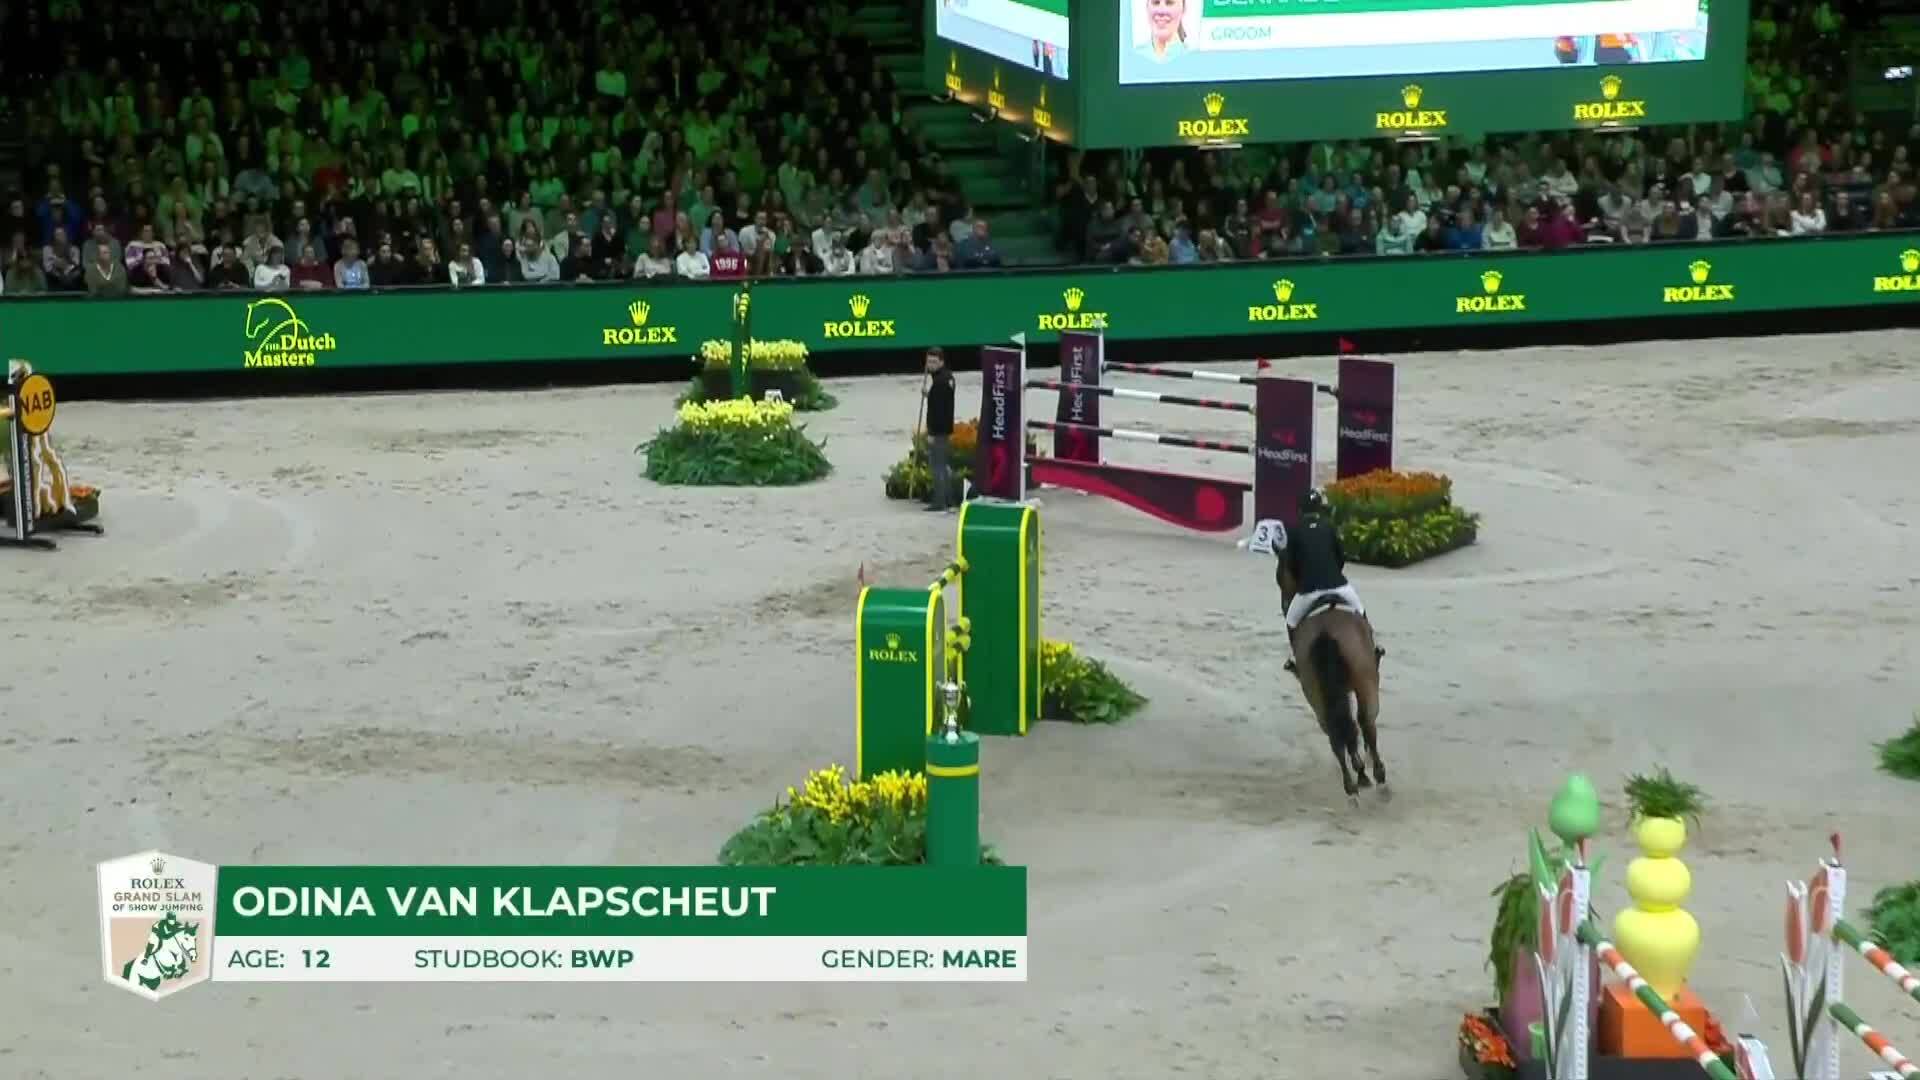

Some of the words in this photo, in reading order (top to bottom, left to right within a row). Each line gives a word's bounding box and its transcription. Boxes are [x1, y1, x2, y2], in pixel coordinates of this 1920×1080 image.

[1211, 26, 1272, 40] GROOM
[1574, 101, 1645, 119] ROLEX
[1178, 119, 1248, 136] ROLEX
[1376, 111, 1447, 128] ROLEX
[1664, 284, 1733, 303] ROLEX
[1249, 304, 1317, 321] ROLEX
[1456, 295, 1525, 313] ROLEX
[824, 320, 895, 338] ROLEX
[1039, 313, 1108, 330] ROLEX
[280, 333, 336, 351] Dutch
[603, 326, 676, 345] ROLEX
[244, 351, 315, 368] Masters
[991, 363, 1006, 440] HeadFirst
[1258, 447, 1309, 463] HeadFirst
[1259, 525, 1269, 541] 3
[869, 649, 918, 662] ROLEX
